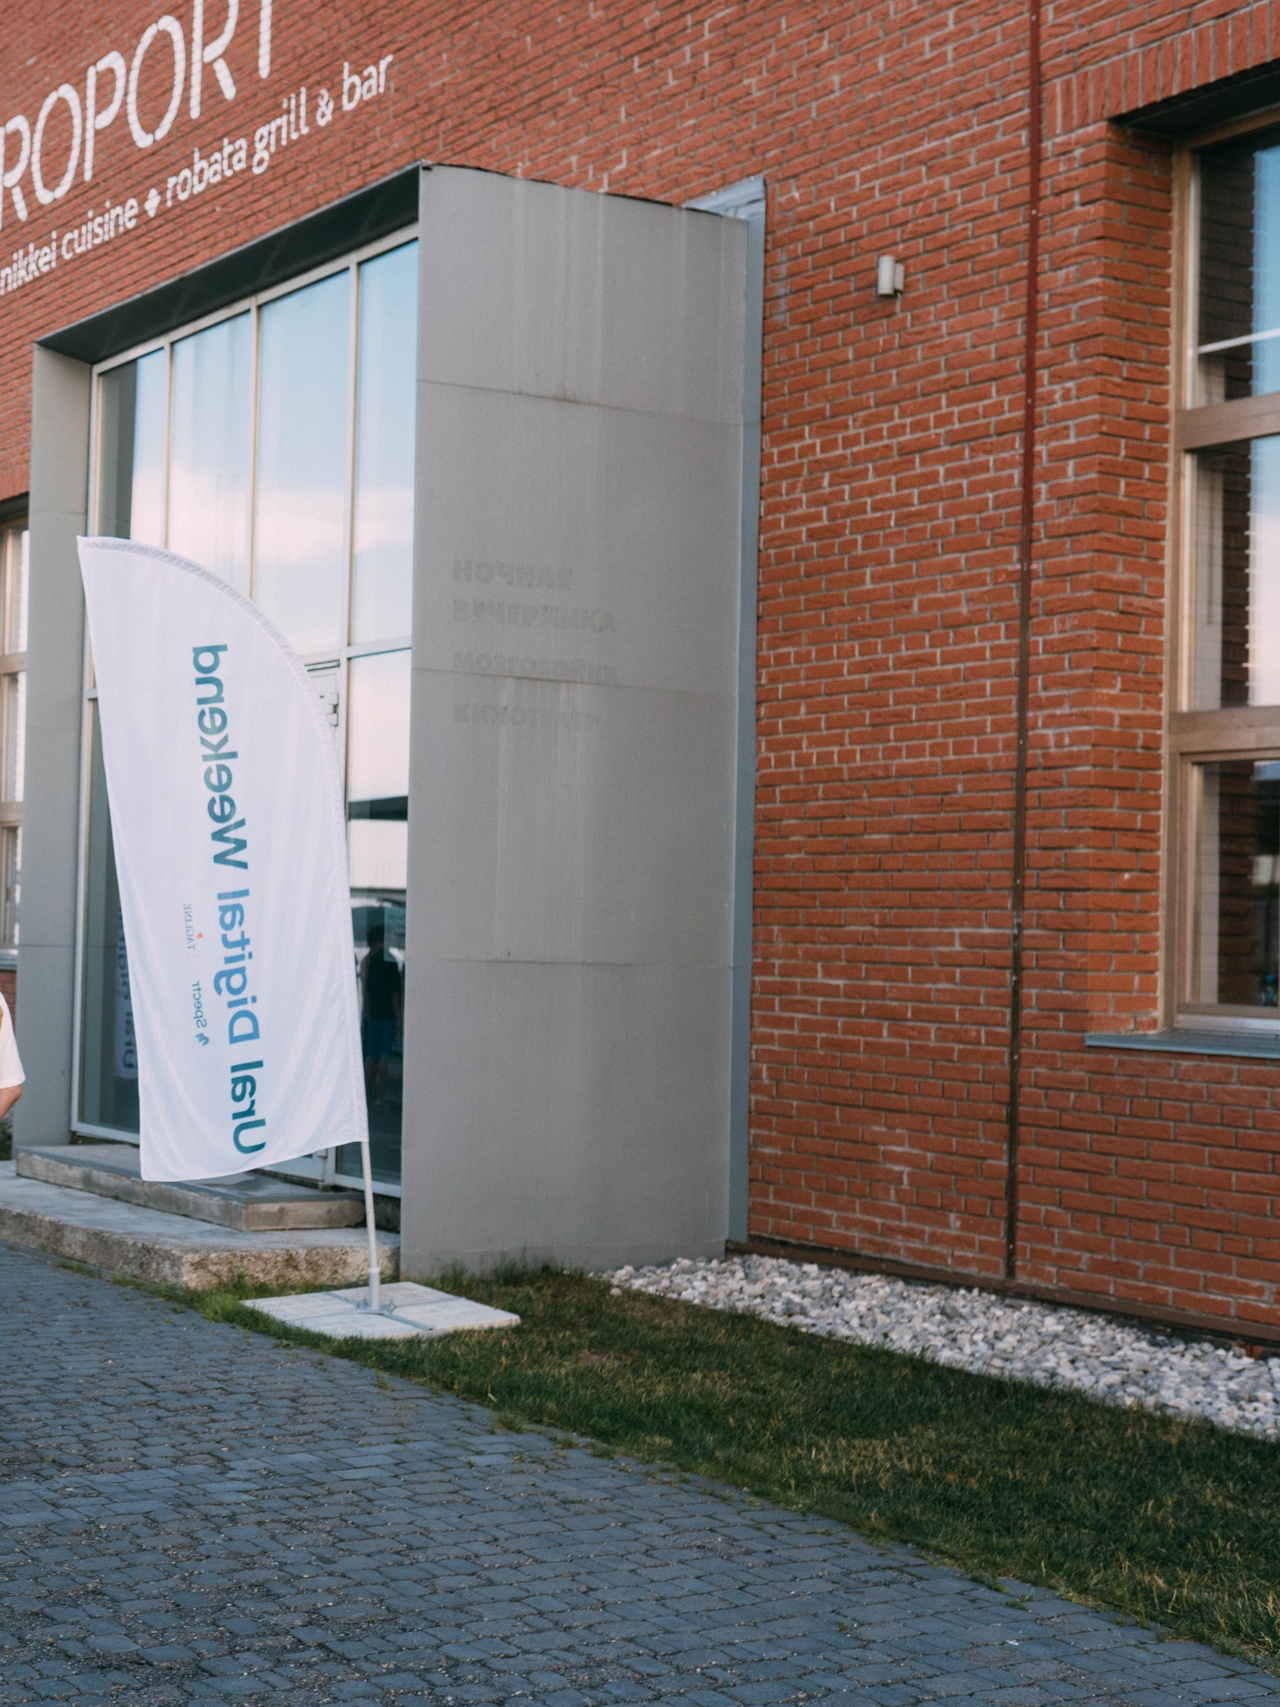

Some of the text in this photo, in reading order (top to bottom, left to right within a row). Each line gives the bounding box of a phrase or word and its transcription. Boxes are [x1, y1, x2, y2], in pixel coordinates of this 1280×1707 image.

[0, 54, 395, 296] nikkei cuisine robata grill & bar
